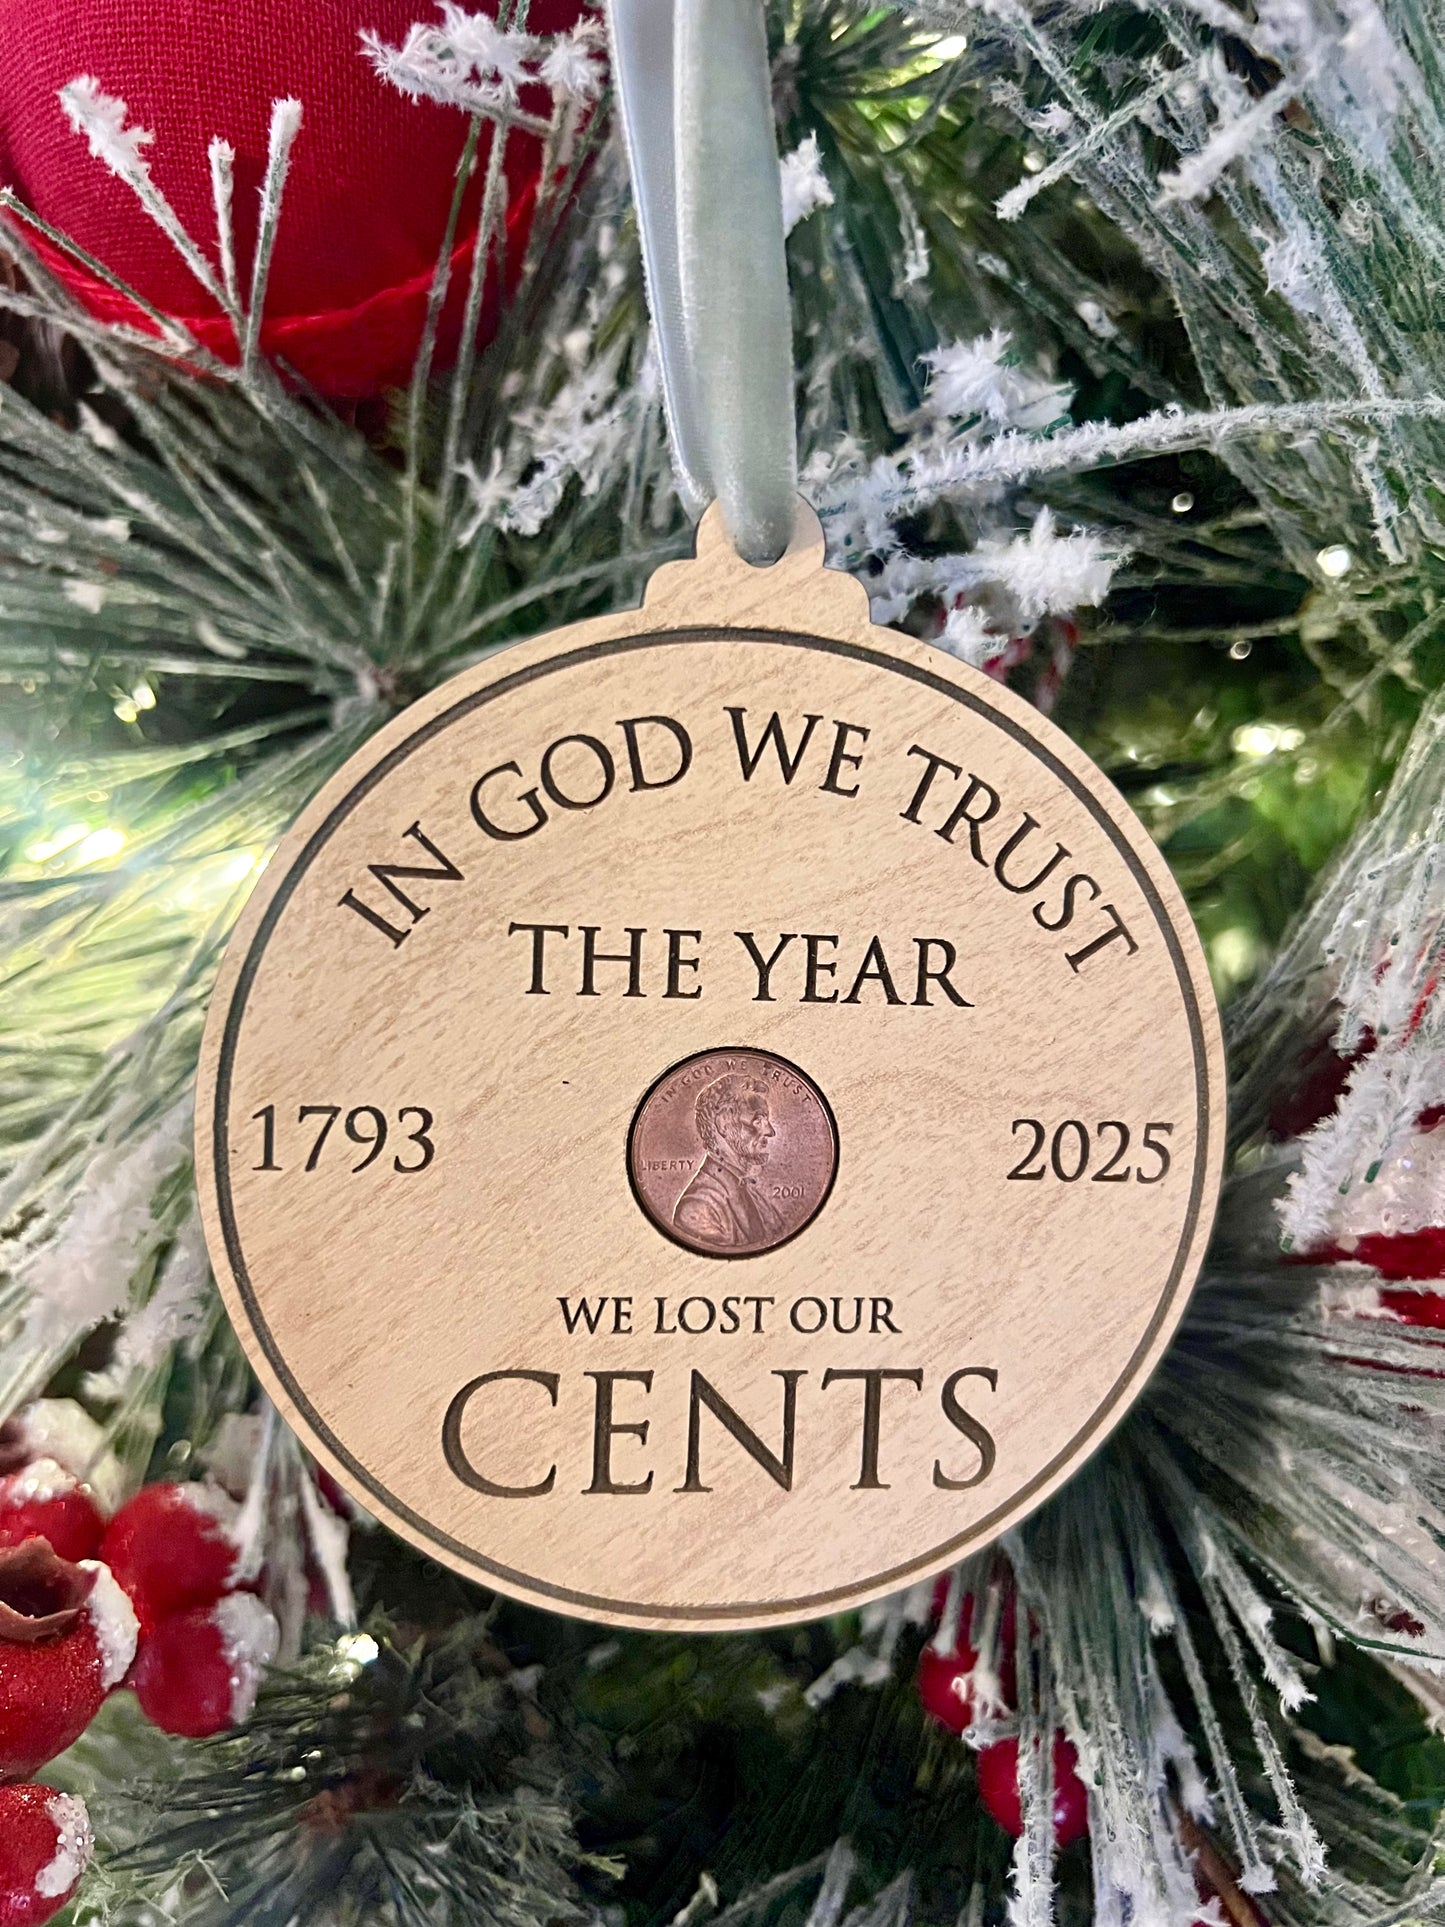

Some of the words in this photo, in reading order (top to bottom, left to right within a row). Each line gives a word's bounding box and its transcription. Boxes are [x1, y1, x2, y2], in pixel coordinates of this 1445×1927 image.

[338, 821, 464, 949] IN
[470, 716, 692, 841] GOD
[723, 707, 870, 797] WE
[900, 745, 1137, 973] TRUST
[508, 922, 702, 999] THE
[734, 932, 975, 1007] YEAR
[681, 1065, 715, 1085] GOD
[726, 1060, 748, 1071] WE
[762, 1064, 812, 1103] TRUST
[253, 1105, 434, 1173] 1793
[641, 1160, 695, 1171] LIBERTY
[1007, 1119, 1173, 1183] 2025
[772, 1187, 805, 1199] 2001
[557, 1297, 632, 1334] WE
[654, 1297, 774, 1333] LOST
[790, 1297, 902, 1333] OUR
[442, 1367, 997, 1498] CENTS
